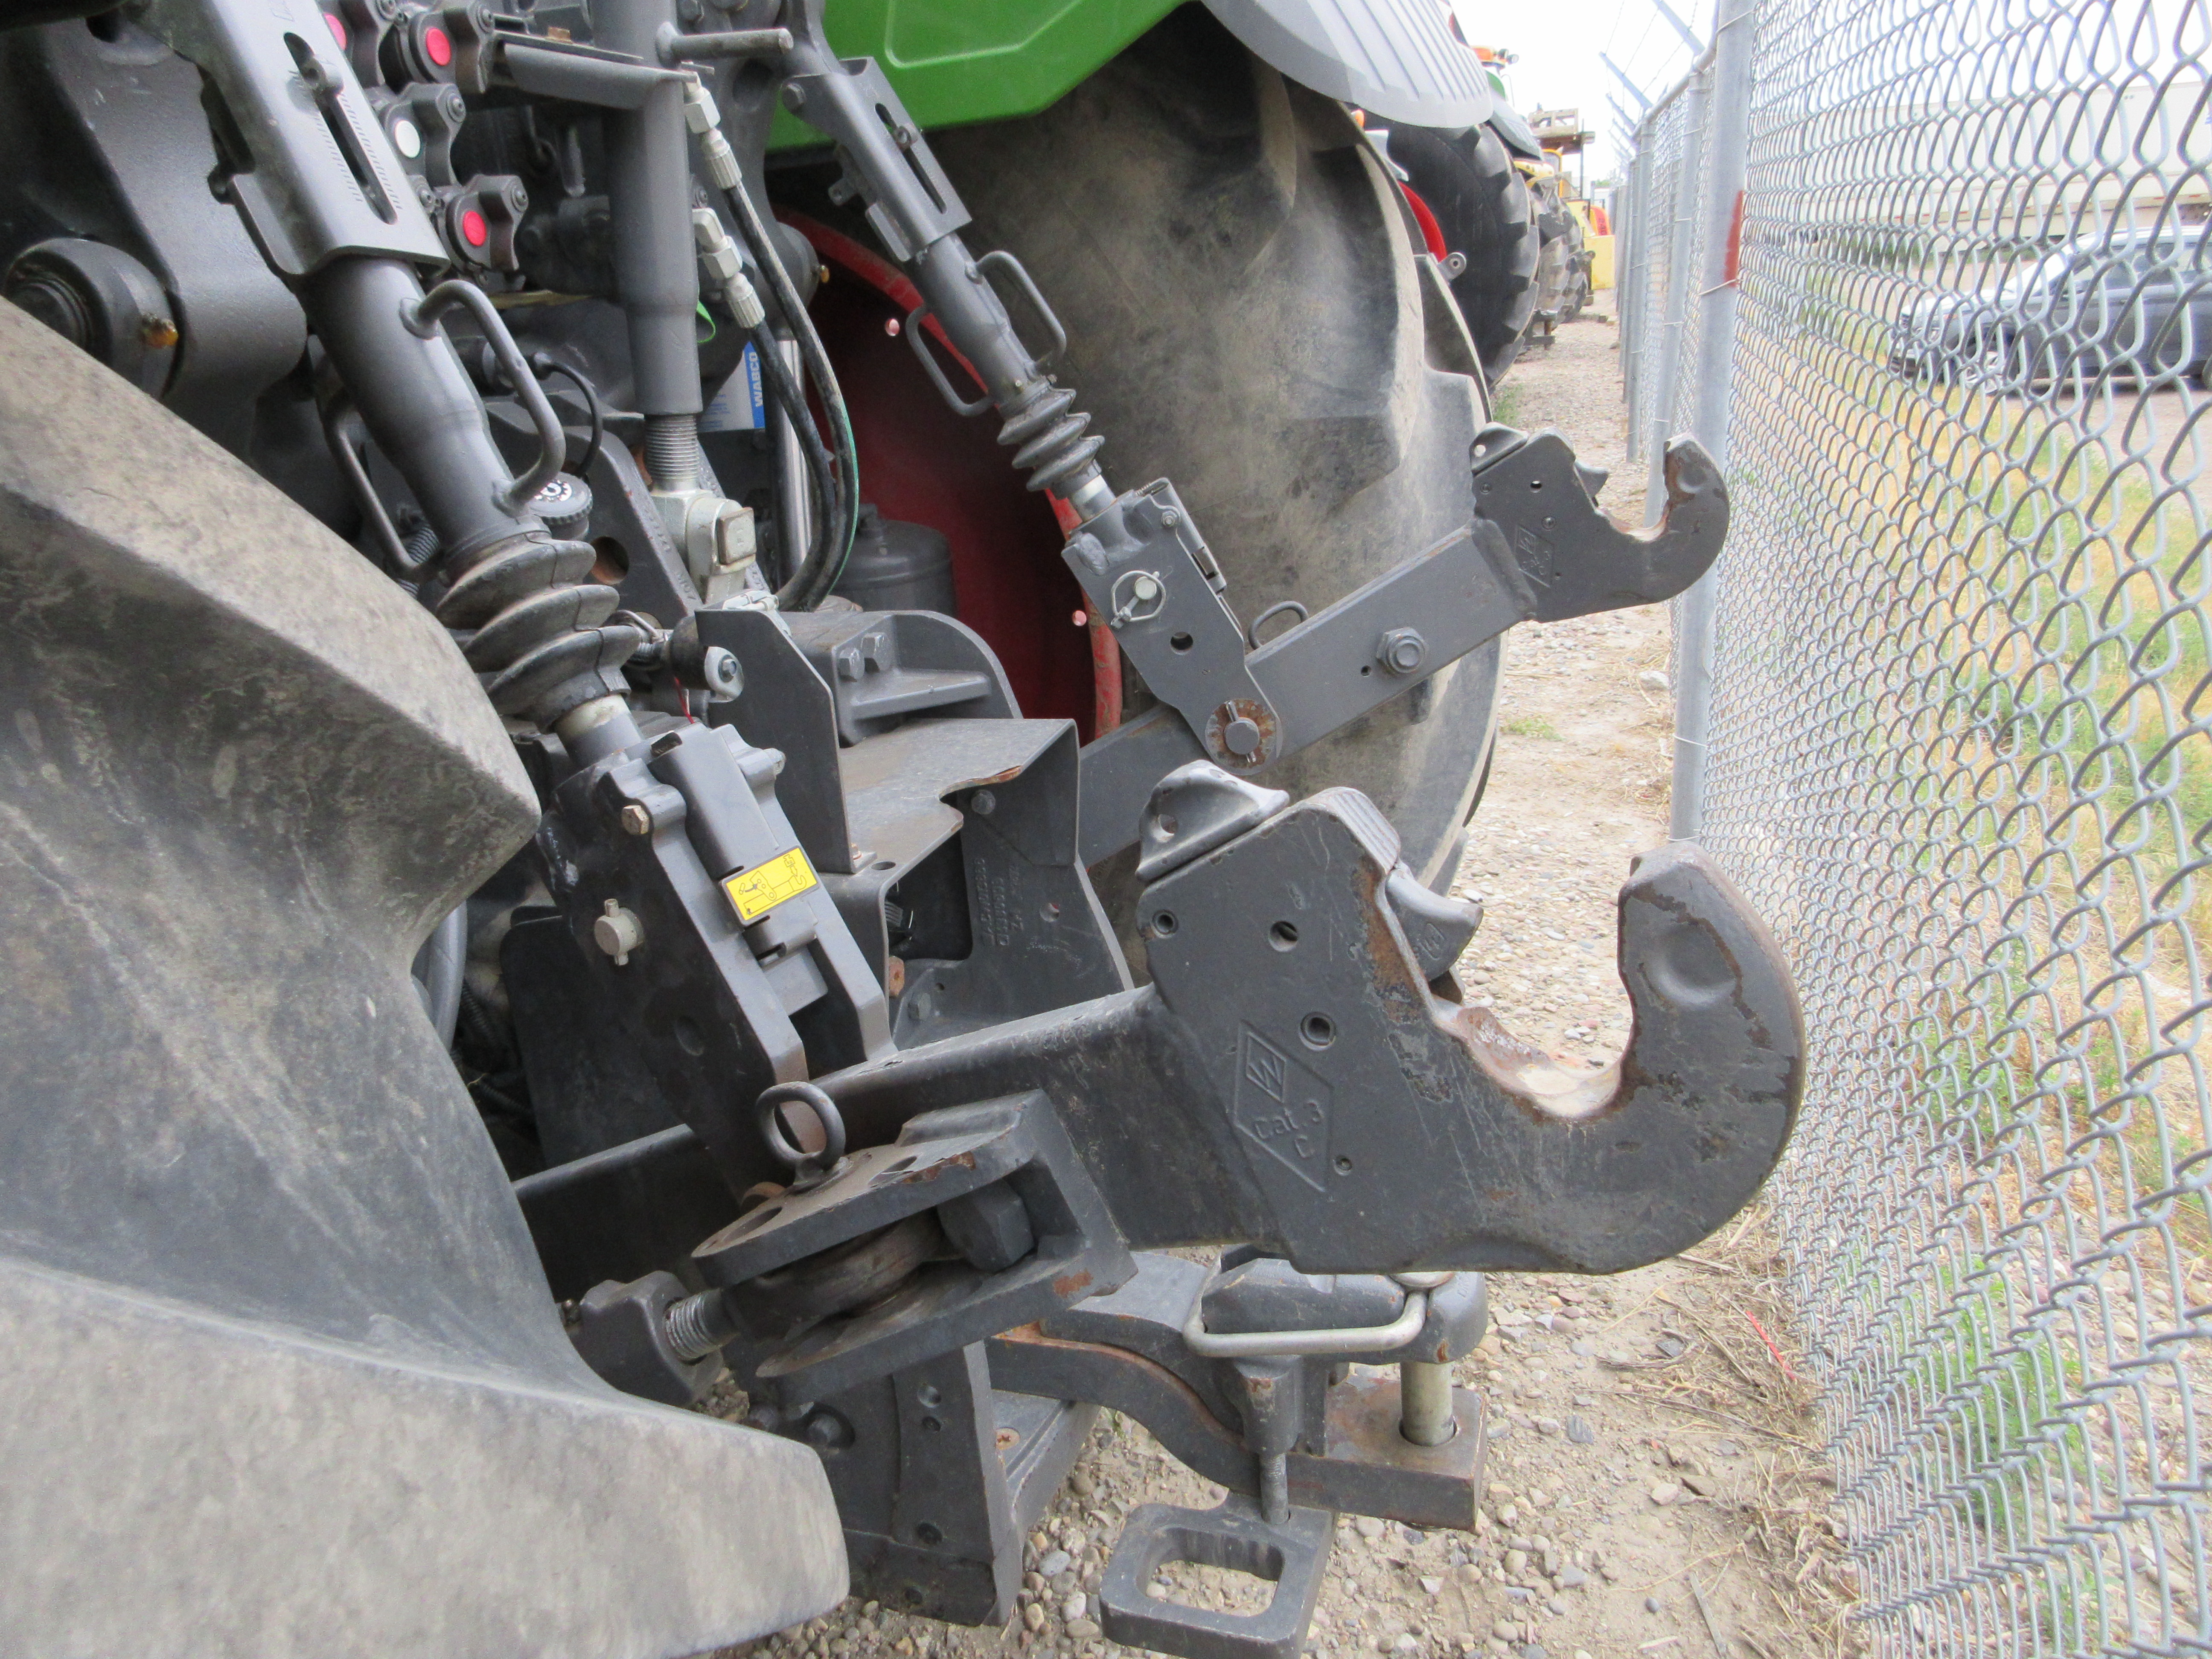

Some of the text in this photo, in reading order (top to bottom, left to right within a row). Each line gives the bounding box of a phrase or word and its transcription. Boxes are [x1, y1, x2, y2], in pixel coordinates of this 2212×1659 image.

[749, 352, 763, 407] WABCO
[1304, 1099, 1324, 1123] 3
[1294, 1134, 1313, 1158] C
